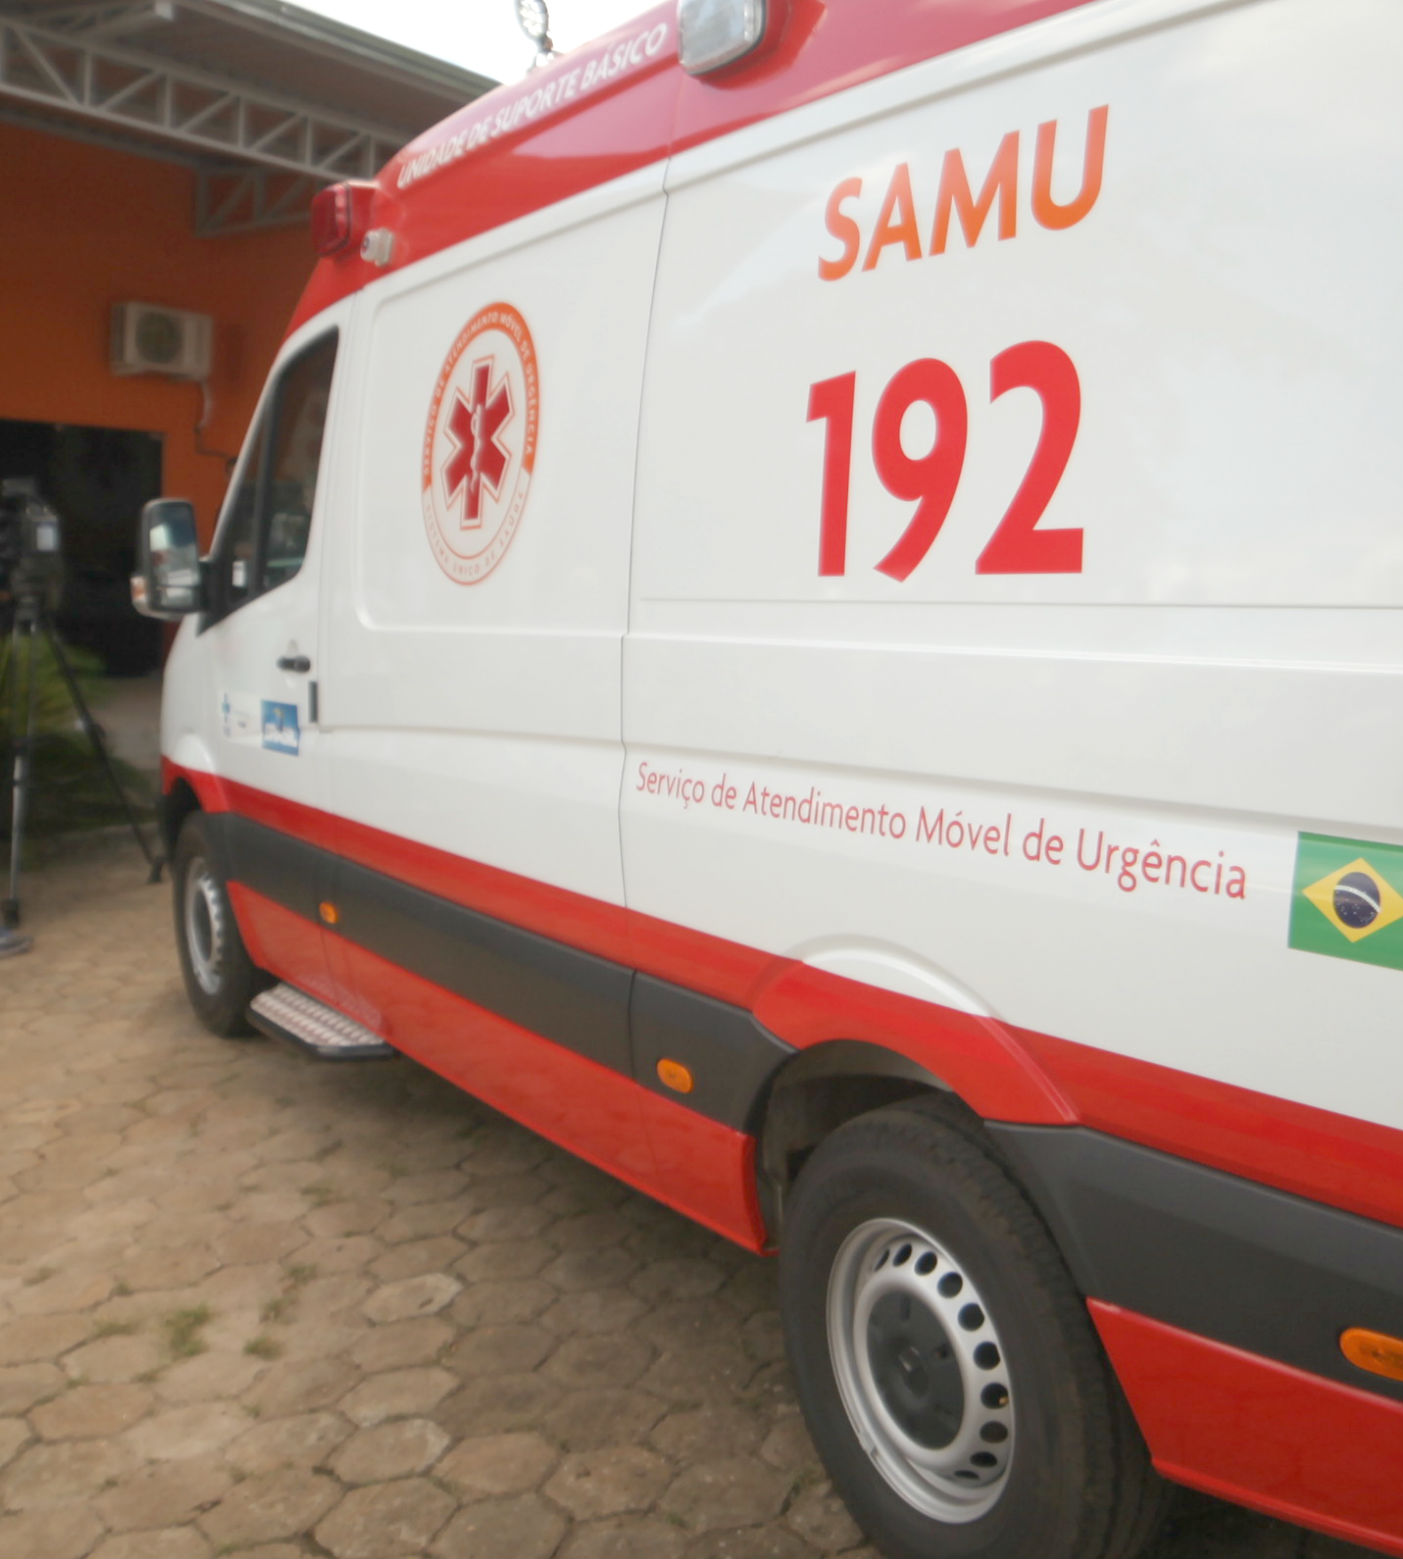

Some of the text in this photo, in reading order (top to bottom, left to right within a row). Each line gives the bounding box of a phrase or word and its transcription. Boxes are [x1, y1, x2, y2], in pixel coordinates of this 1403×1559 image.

[397, 129, 468, 189] UNIDADE
[466, 116, 493, 149] DE
[491, 66, 583, 138] SUPORTE
[817, 104, 1109, 281] SAMU
[806, 340, 1084, 583] 192
[635, 761, 1248, 899] Serviço de Atendimento Móvel de Urgência
